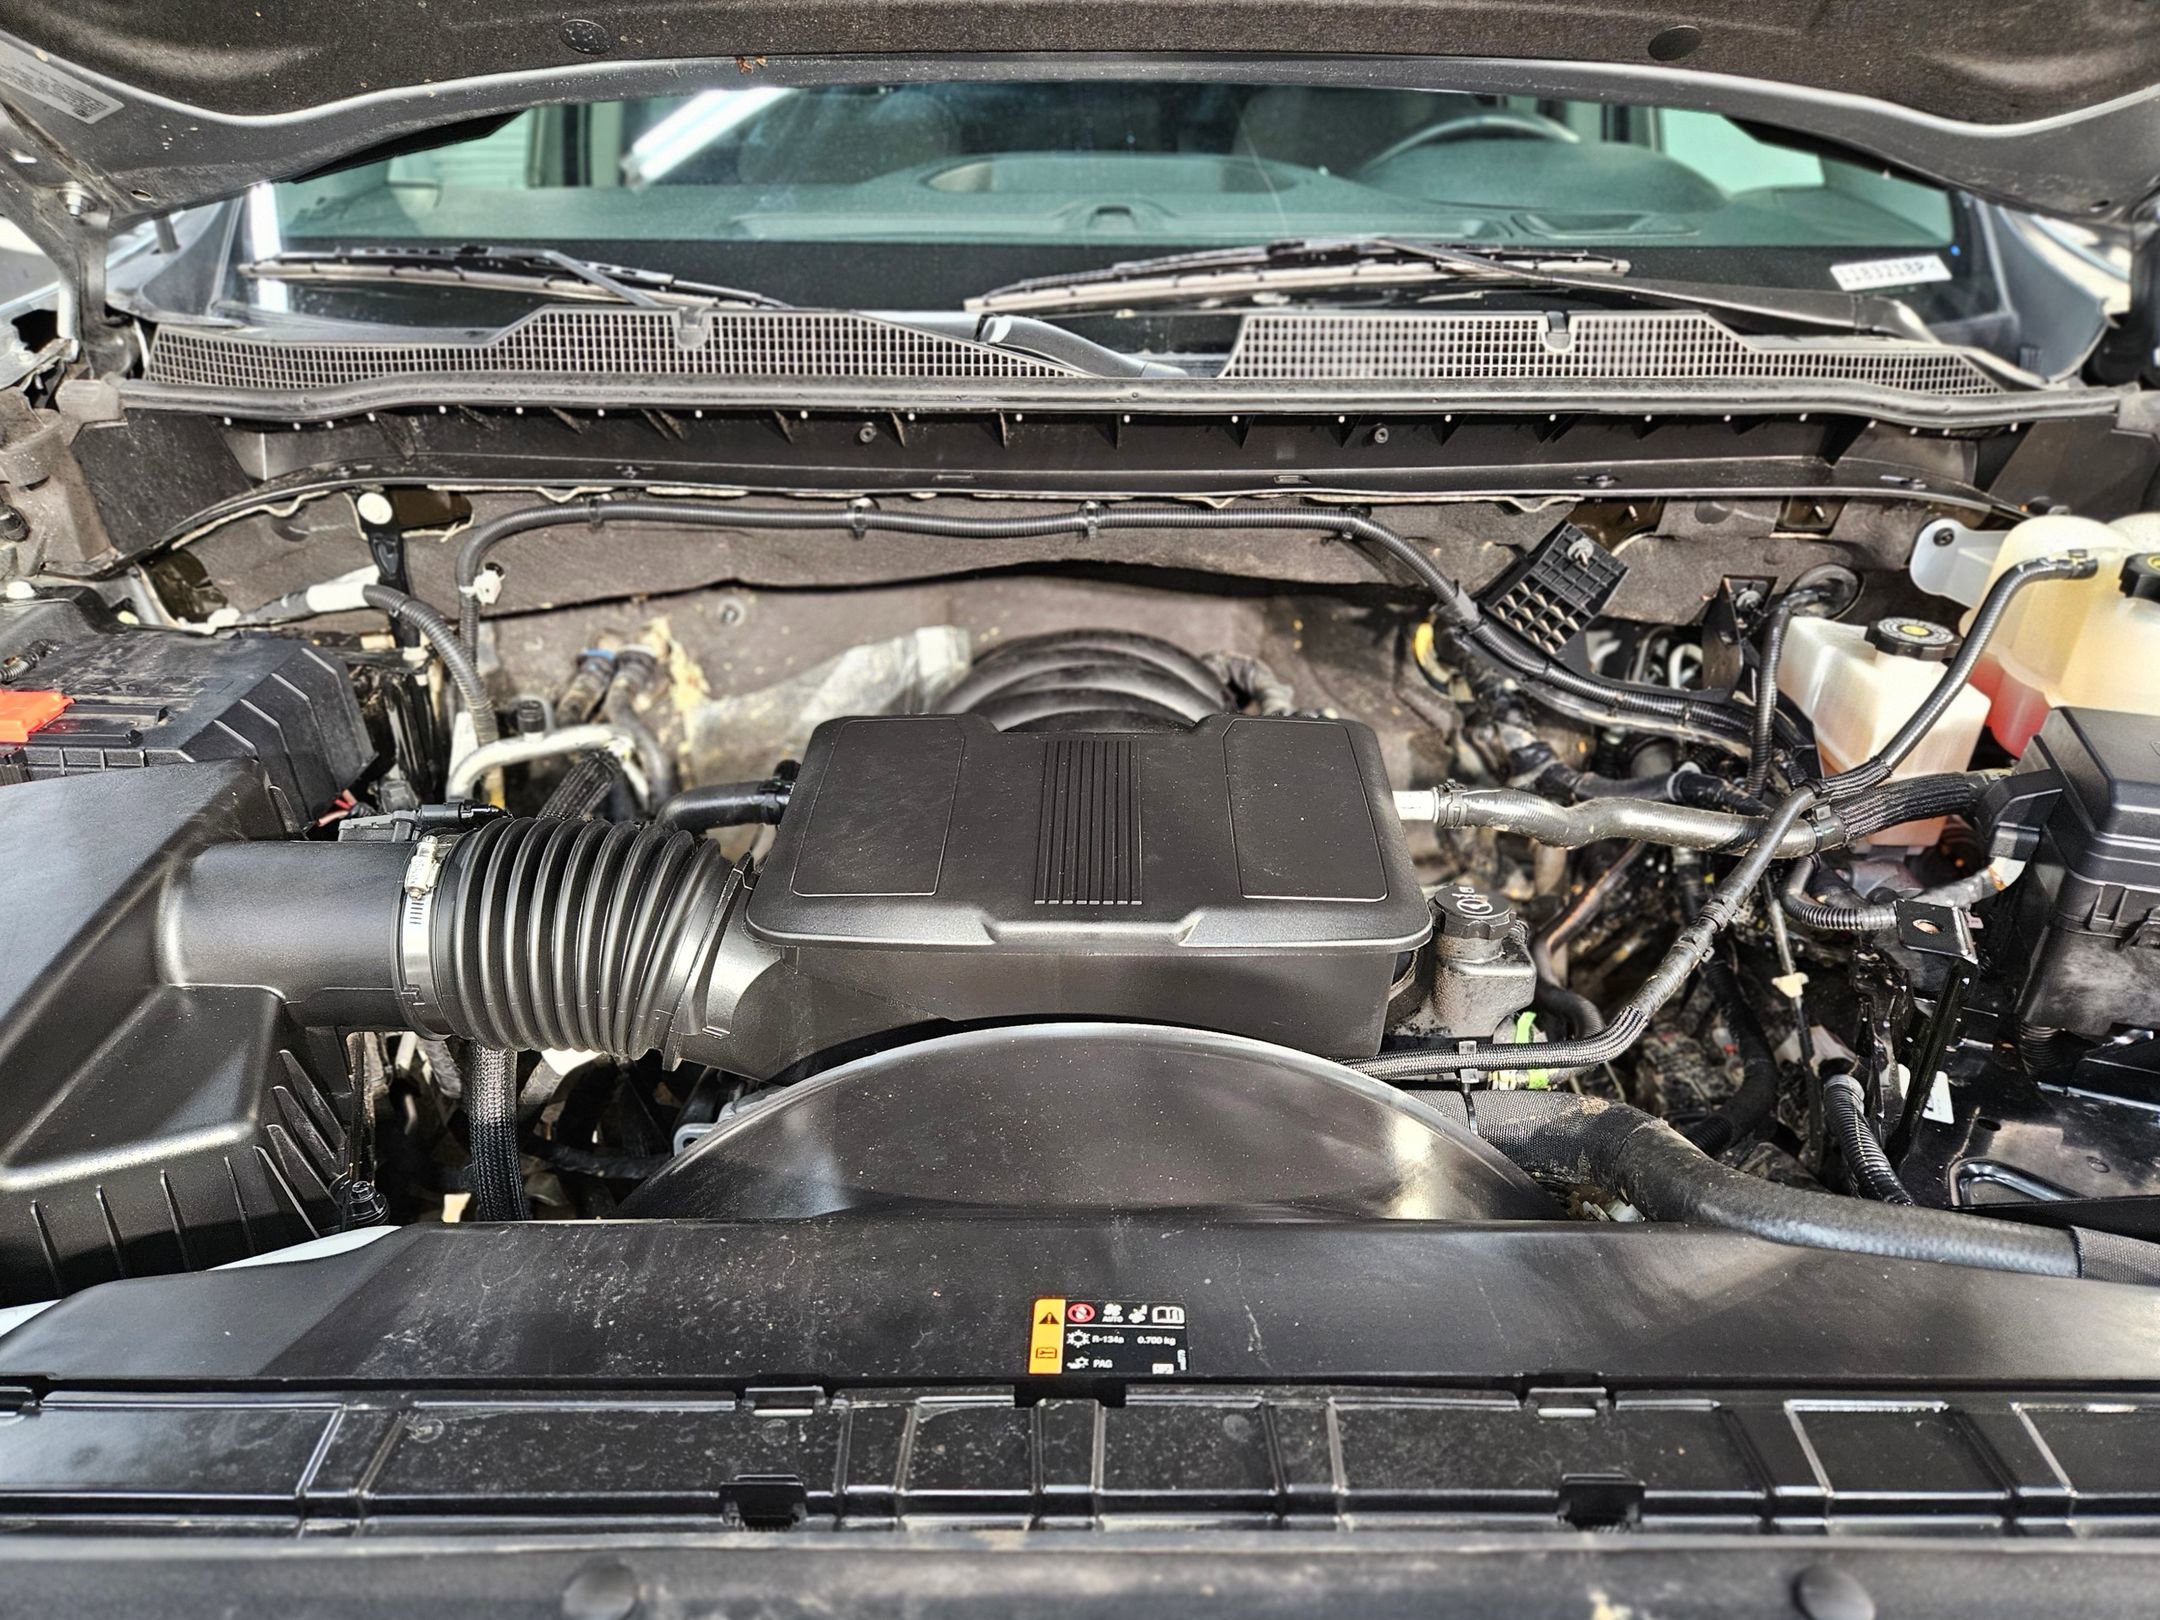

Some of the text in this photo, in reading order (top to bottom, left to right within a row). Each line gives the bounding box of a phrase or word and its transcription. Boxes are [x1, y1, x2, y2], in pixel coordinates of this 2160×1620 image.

[1102, 1315, 1124, 1323] AUTO
[1092, 1335, 1176, 1346] R-134a 0.700 kg
[1093, 1359, 1113, 1368] PAG
